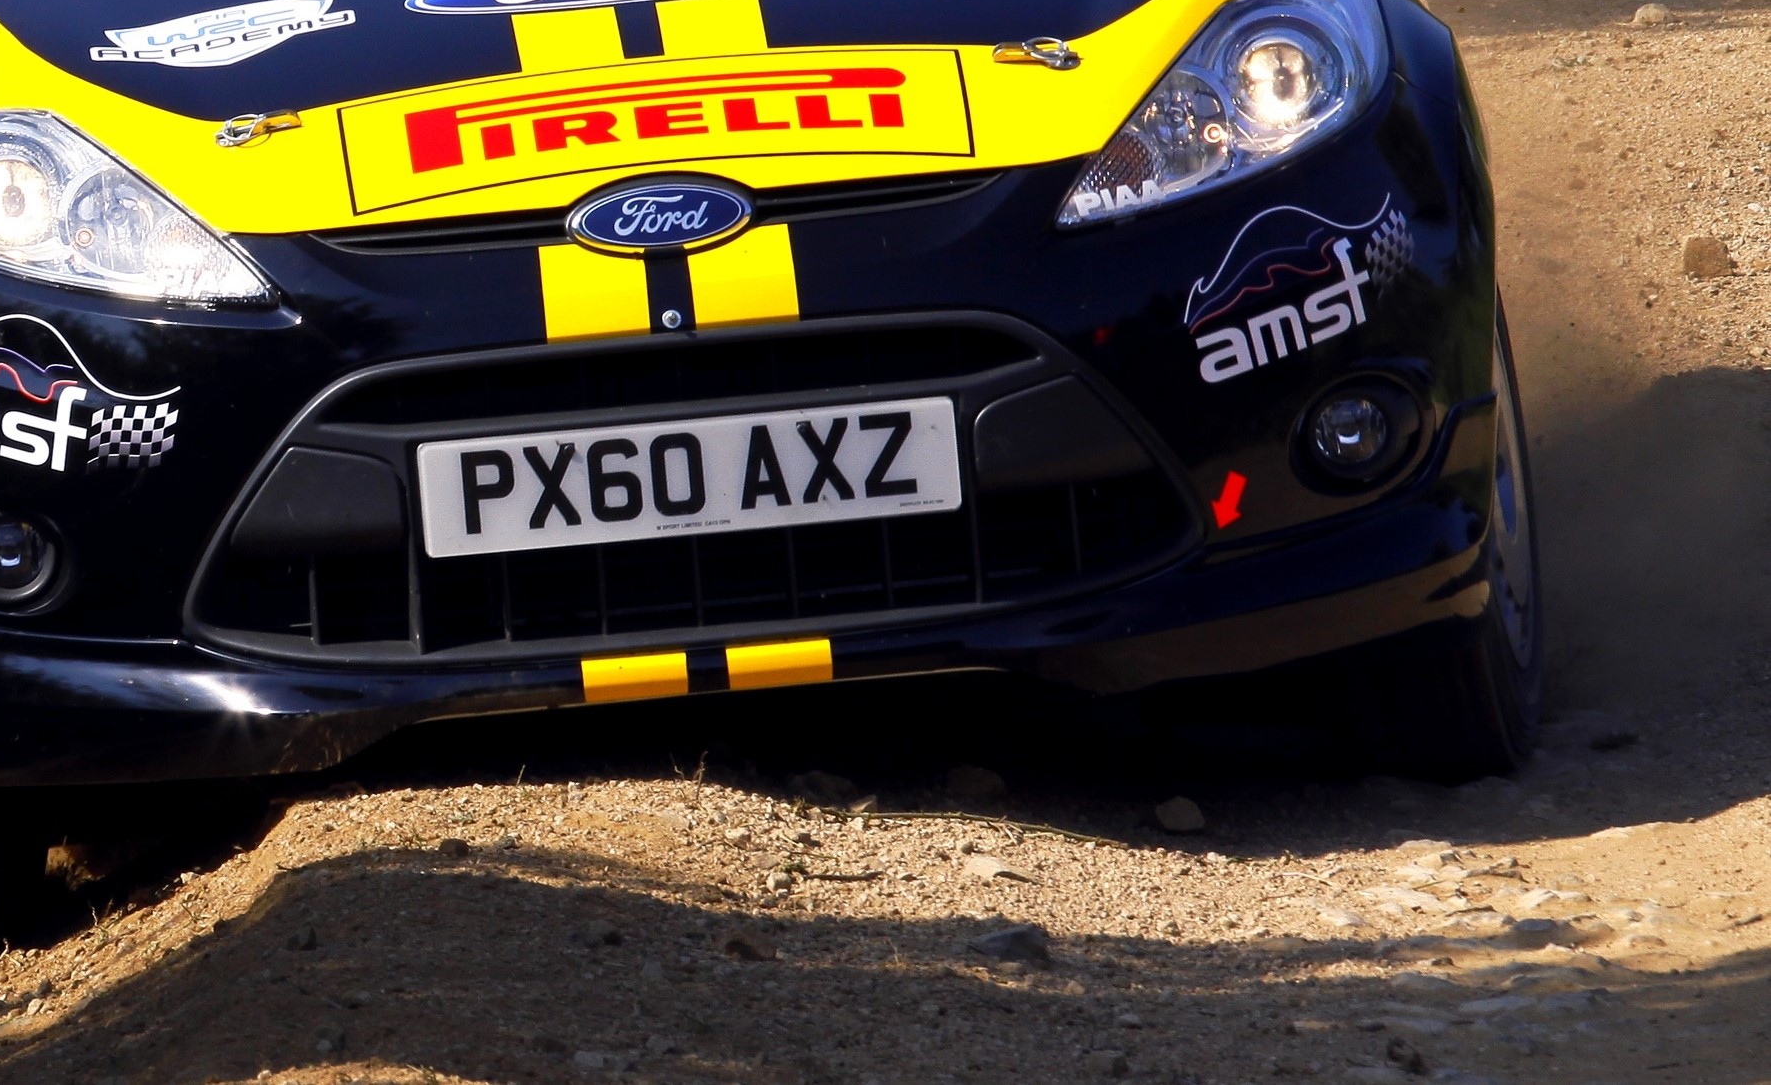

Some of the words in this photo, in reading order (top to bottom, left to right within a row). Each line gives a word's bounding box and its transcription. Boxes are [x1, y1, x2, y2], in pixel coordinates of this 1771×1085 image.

[97, 12, 349, 59] ACADEMY
[404, 67, 907, 174] PIRELLI
[613, 194, 709, 236] Ford
[1072, 179, 1166, 217] PIAA
[1195, 237, 1370, 384] amsf
[459, 432, 706, 535] PX60
[741, 411, 918, 511] AXZ
